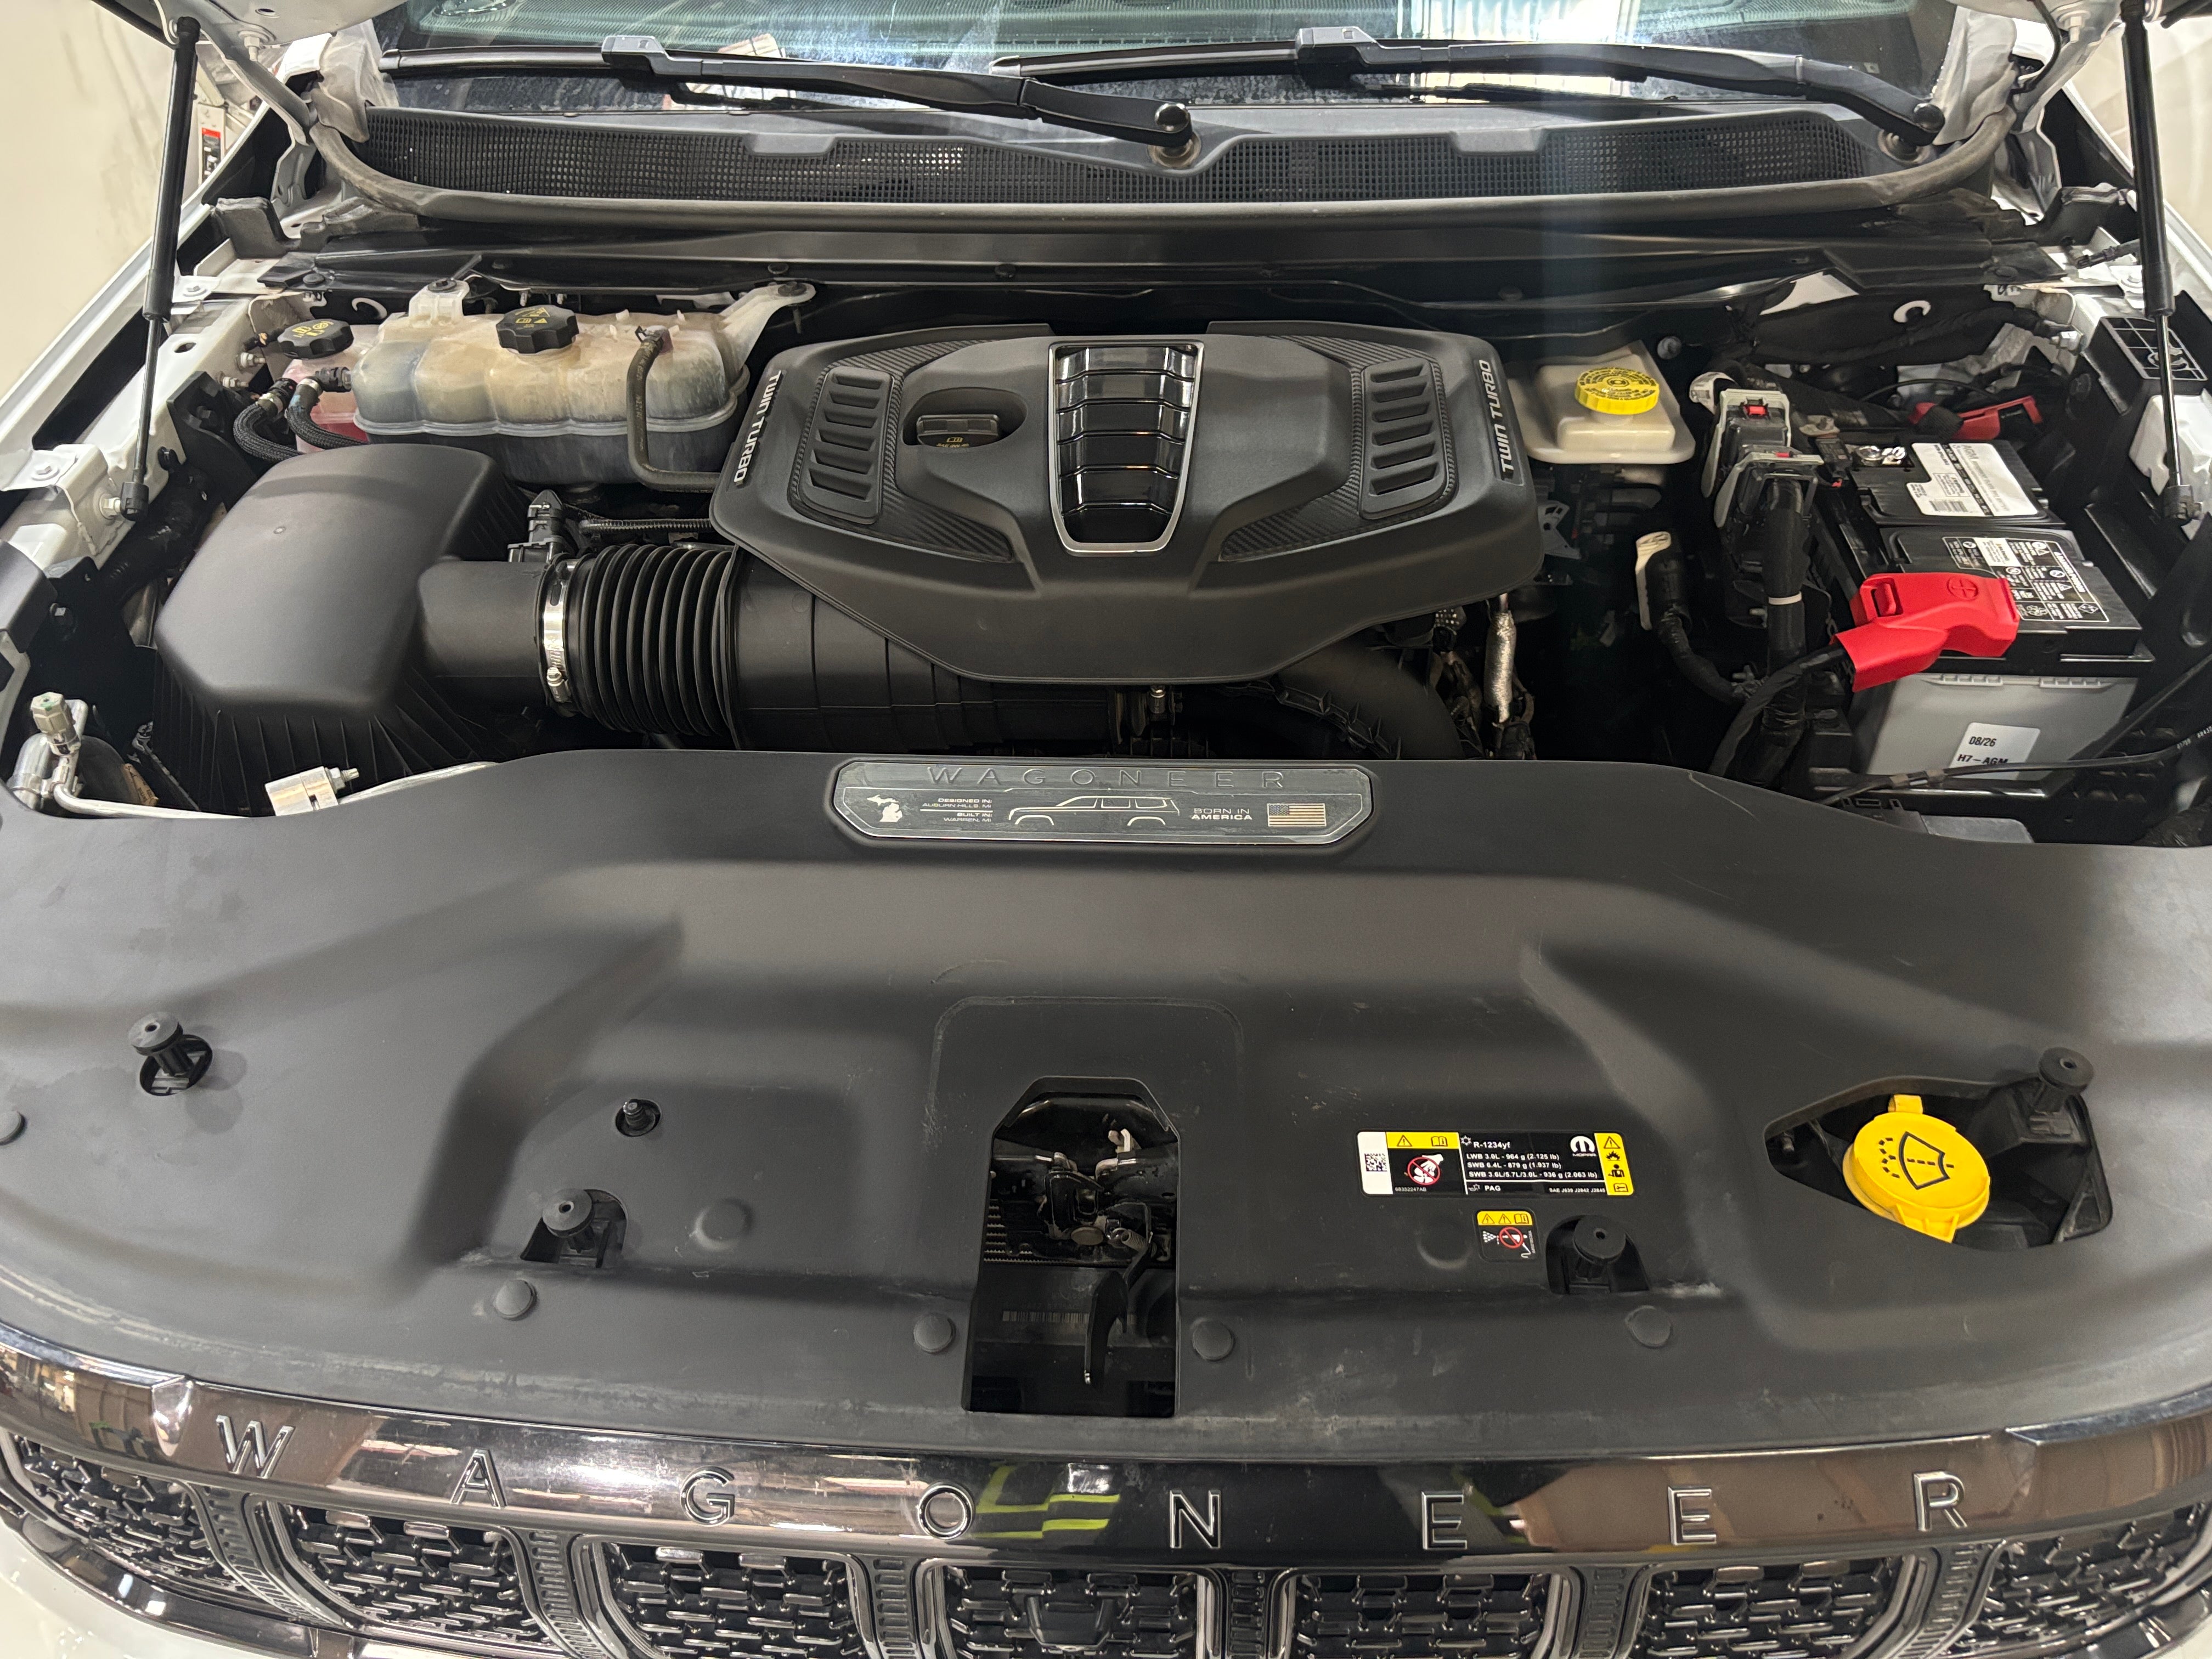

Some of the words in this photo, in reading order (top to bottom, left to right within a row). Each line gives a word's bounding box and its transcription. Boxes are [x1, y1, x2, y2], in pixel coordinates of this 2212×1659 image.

[757, 370, 782, 415] TWIN
[1479, 359, 1503, 419] TURBO
[734, 416, 765, 482] TURBO
[1494, 424, 1514, 472] TWIN
[1968, 736, 1997, 747] 08/26
[927, 767, 1284, 788] WAGONEER
[1473, 1141, 1510, 1150] R-1234yf
[216, 1415, 1968, 1550] WAGONEER
